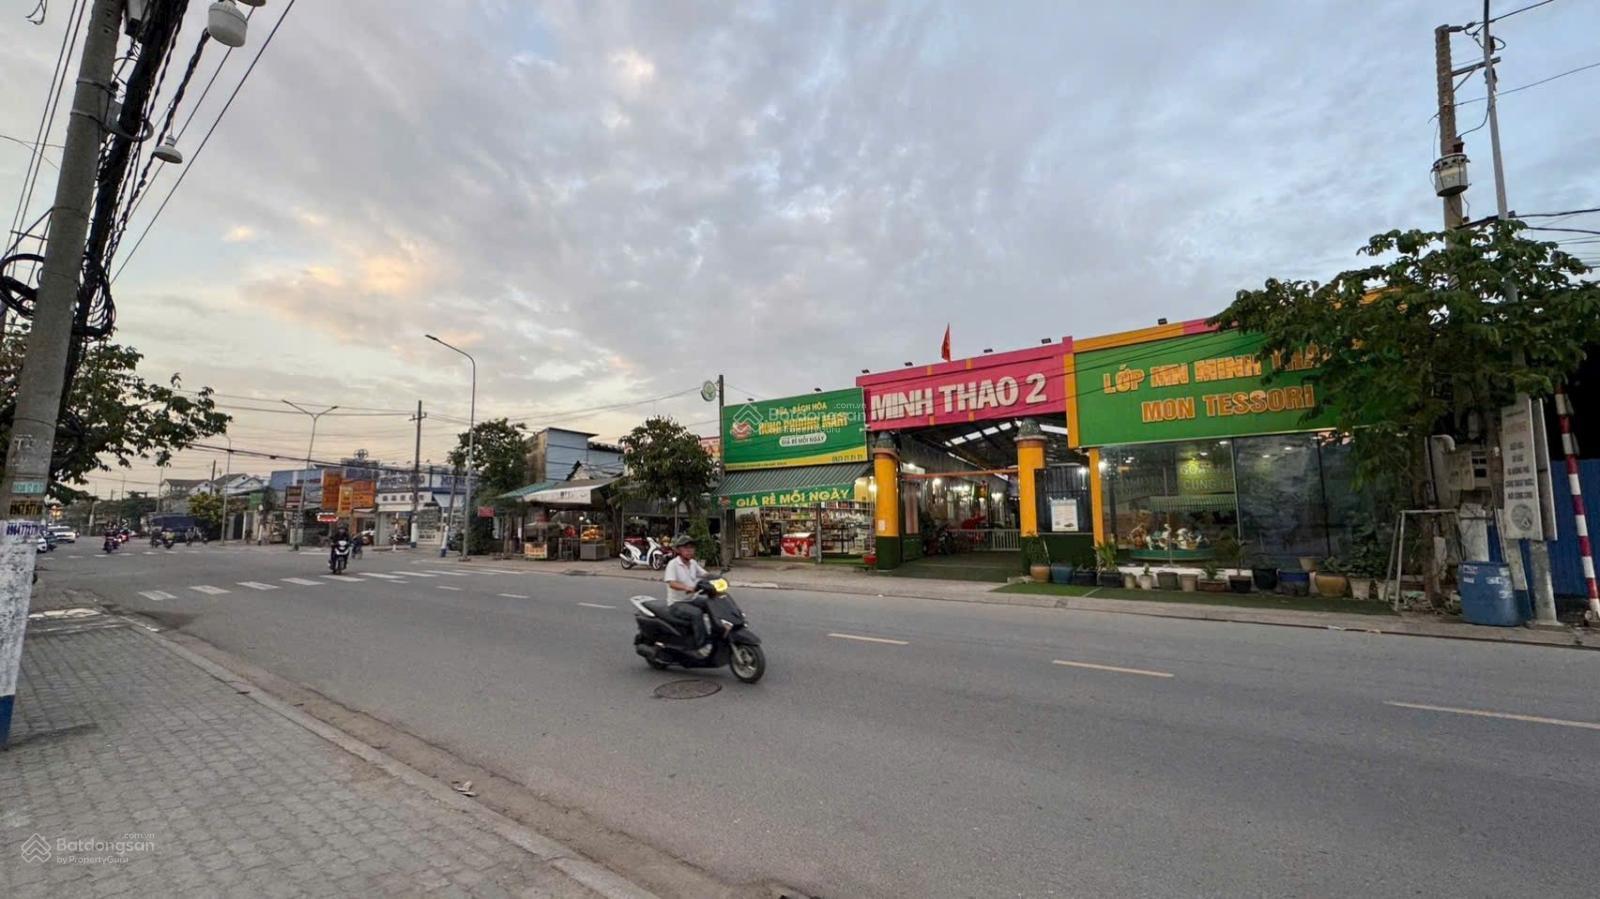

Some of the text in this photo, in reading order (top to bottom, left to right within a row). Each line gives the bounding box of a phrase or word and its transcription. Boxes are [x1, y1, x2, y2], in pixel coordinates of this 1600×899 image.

[871, 387, 934, 421] MINH
[1025, 372, 1048, 404] 2
[1141, 384, 1315, 423] MON TESSORI
[736, 494, 758, 508] GIÁ
[780, 489, 804, 504] MỖI
[809, 487, 849, 502] NGÀY
